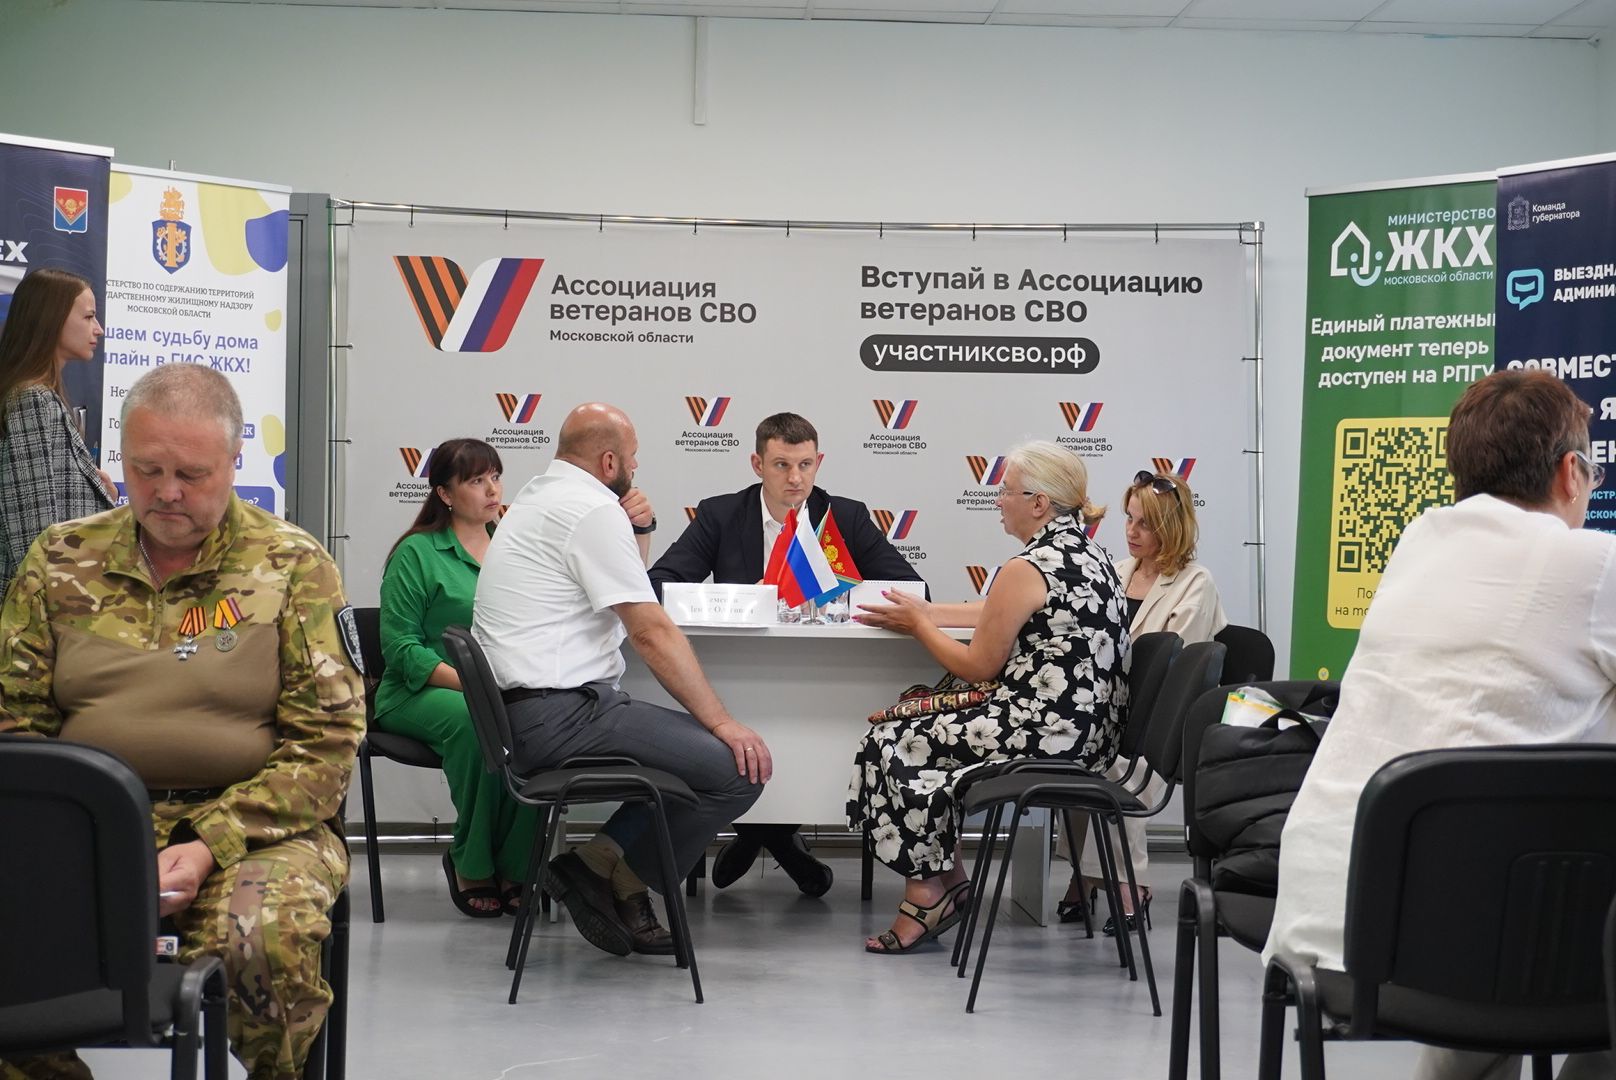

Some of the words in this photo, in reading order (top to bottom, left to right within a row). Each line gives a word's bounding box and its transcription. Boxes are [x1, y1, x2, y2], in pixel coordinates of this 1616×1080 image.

[1532, 202, 1566, 213] Команда
[1388, 207, 1496, 226] министерство
[1532, 210, 1580, 223] губернатора
[1385, 224, 1495, 272] ЖКХ
[1384, 271, 1447, 285] московской
[1449, 270, 1494, 282] области
[1554, 263, 1616, 281] ВЫЕЗДН
[551, 274, 716, 300] Ассоциация
[861, 265, 985, 295] Вступай
[994, 272, 1009, 290] в
[1018, 268, 1203, 296] Ассоциацию
[143, 282, 154, 290] ПО
[155, 283, 207, 296] СОДЕРЖАНИЮ
[208, 288, 255, 299] ТЕРРИТОРИЙ
[1553, 284, 1616, 303] АДМИНИ
[127, 304, 178, 315] МОСКОВСКОЙ
[178, 310, 211, 318] ОБЛАСТИ
[167, 296, 219, 307] ЖИЛИЩНОМУ
[219, 301, 253, 310] НАДЗОРУ
[549, 302, 692, 325] ветеранов
[700, 302, 757, 324] СВО
[861, 300, 1016, 325] ветеранов
[1024, 300, 1088, 324] СВО
[1311, 315, 1385, 336] Единый
[153, 330, 211, 350] судьбу
[215, 335, 258, 350] дома
[550, 329, 634, 343] Московской
[637, 330, 694, 344] области
[873, 342, 1087, 368] участниксво.рф
[1321, 343, 1414, 362] документ
[1418, 339, 1489, 359] теперь
[1319, 368, 1406, 389] доступен
[1412, 367, 1437, 384] на
[485, 436, 530, 444] ветеранов
[532, 436, 550, 444] СВО
[492, 427, 544, 437] Ассоциация
[681, 430, 733, 439] Ассоциация
[869, 433, 921, 442] Ассоциация
[1056, 436, 1106, 444] Ассоциация
[675, 439, 719, 447] ветеранов
[721, 439, 740, 447] СВО
[863, 441, 907, 450] ветеранов
[1335, 606, 1349, 616] на
